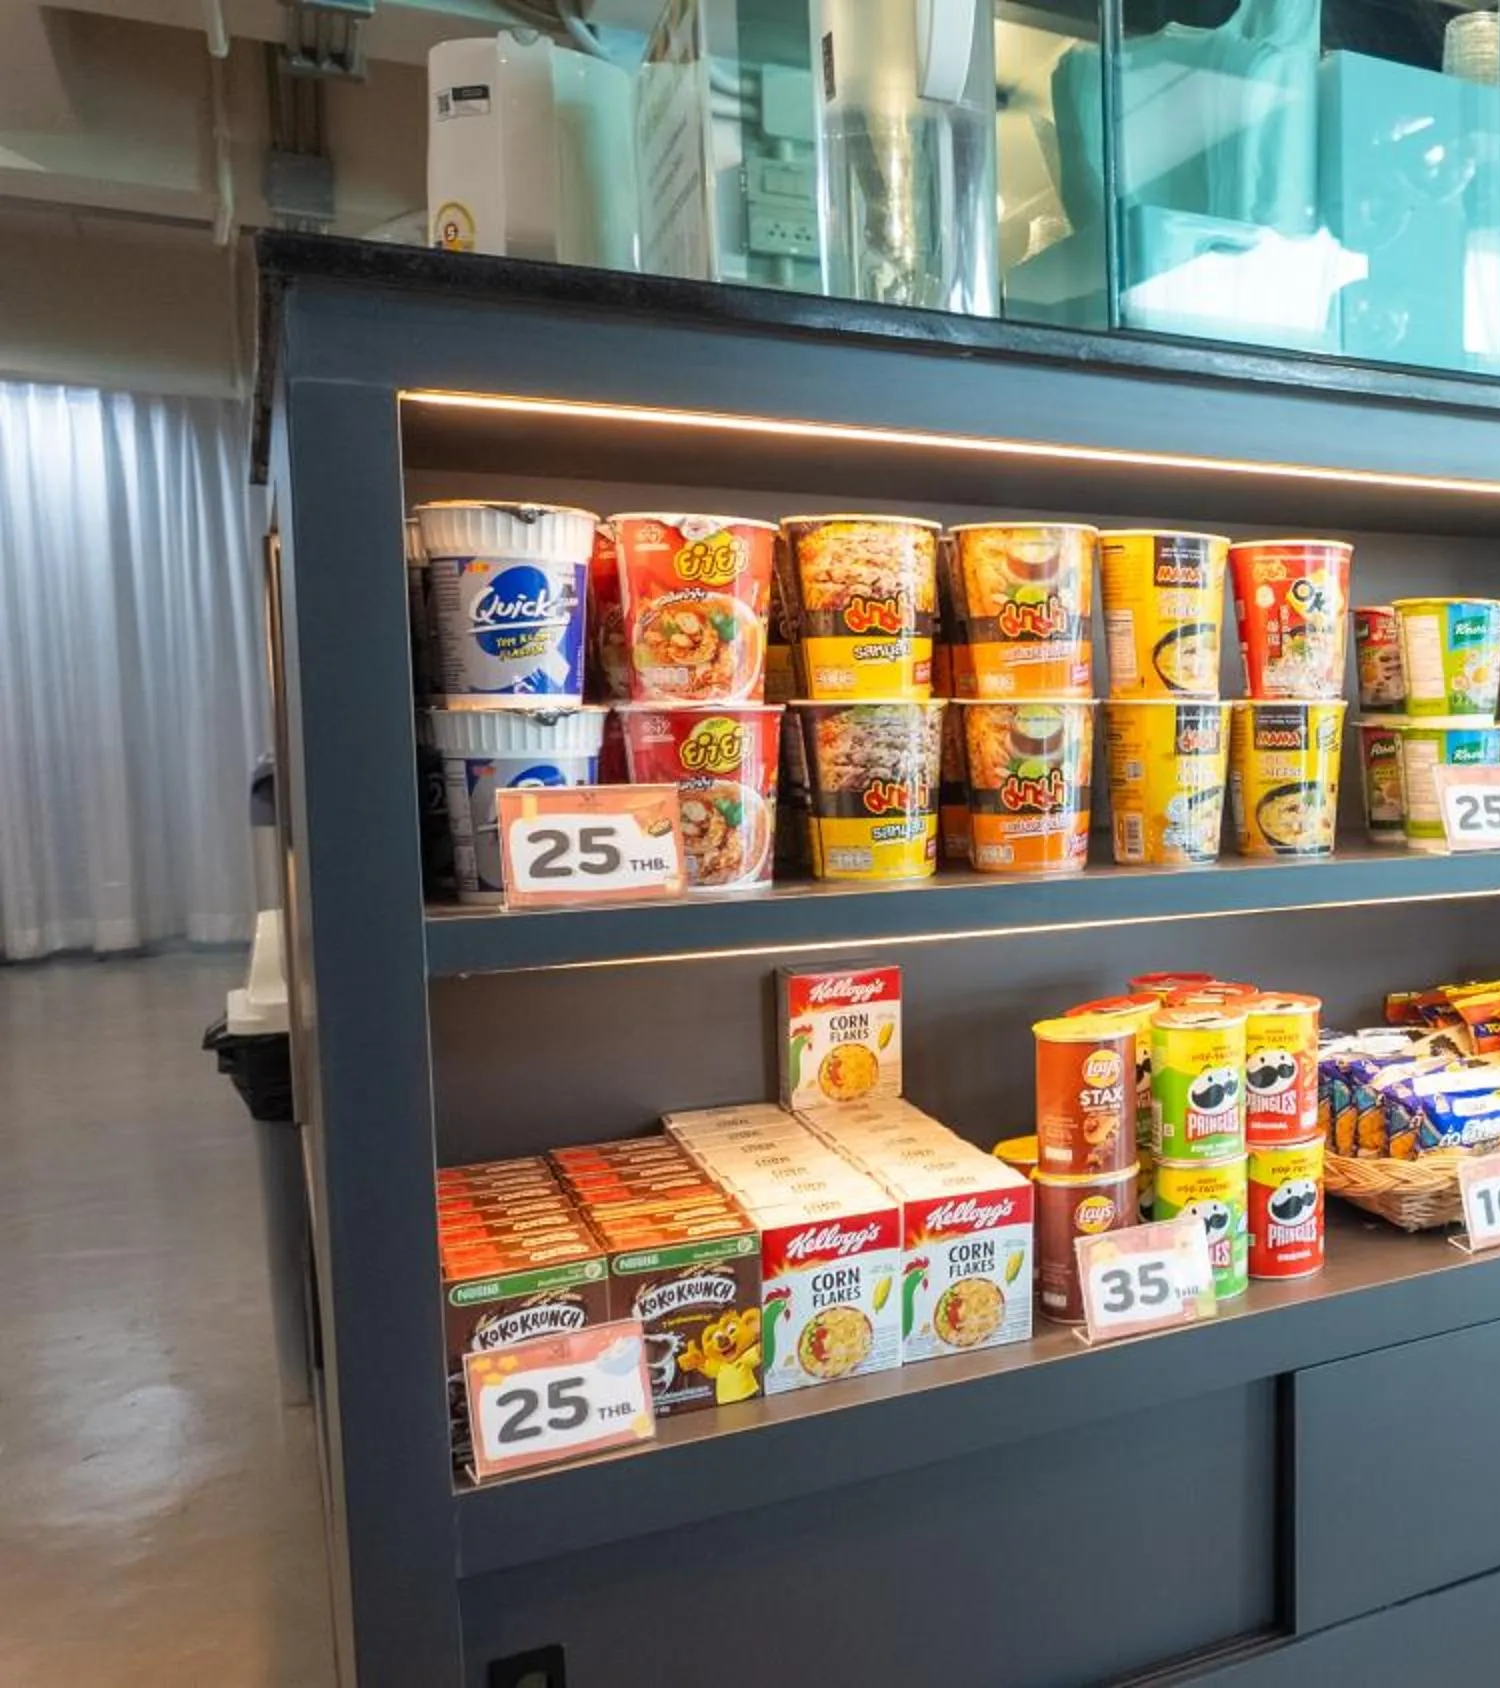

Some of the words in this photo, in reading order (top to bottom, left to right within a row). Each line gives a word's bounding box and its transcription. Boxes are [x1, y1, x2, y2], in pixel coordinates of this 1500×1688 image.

[469, 585, 556, 625] Quick
[1256, 730, 1304, 749] MAMA
[527, 827, 621, 879] 25
[629, 858, 670, 873] THB.
[809, 977, 885, 1003] Kellogg's
[829, 1013, 869, 1031] CORN
[829, 1028, 870, 1044] FLAKES
[1079, 1088, 1125, 1107] STAX
[926, 1198, 1017, 1229] Kellogg's
[786, 1222, 882, 1259] Kellogg's
[948, 1240, 996, 1263] CORN
[811, 1267, 861, 1293] CORN
[948, 1258, 996, 1279] FLAKES
[812, 1287, 862, 1308] FLAKES
[1100, 1261, 1171, 1314] 35
[495, 1376, 590, 1444] 25
[597, 1402, 638, 1421] THB.
